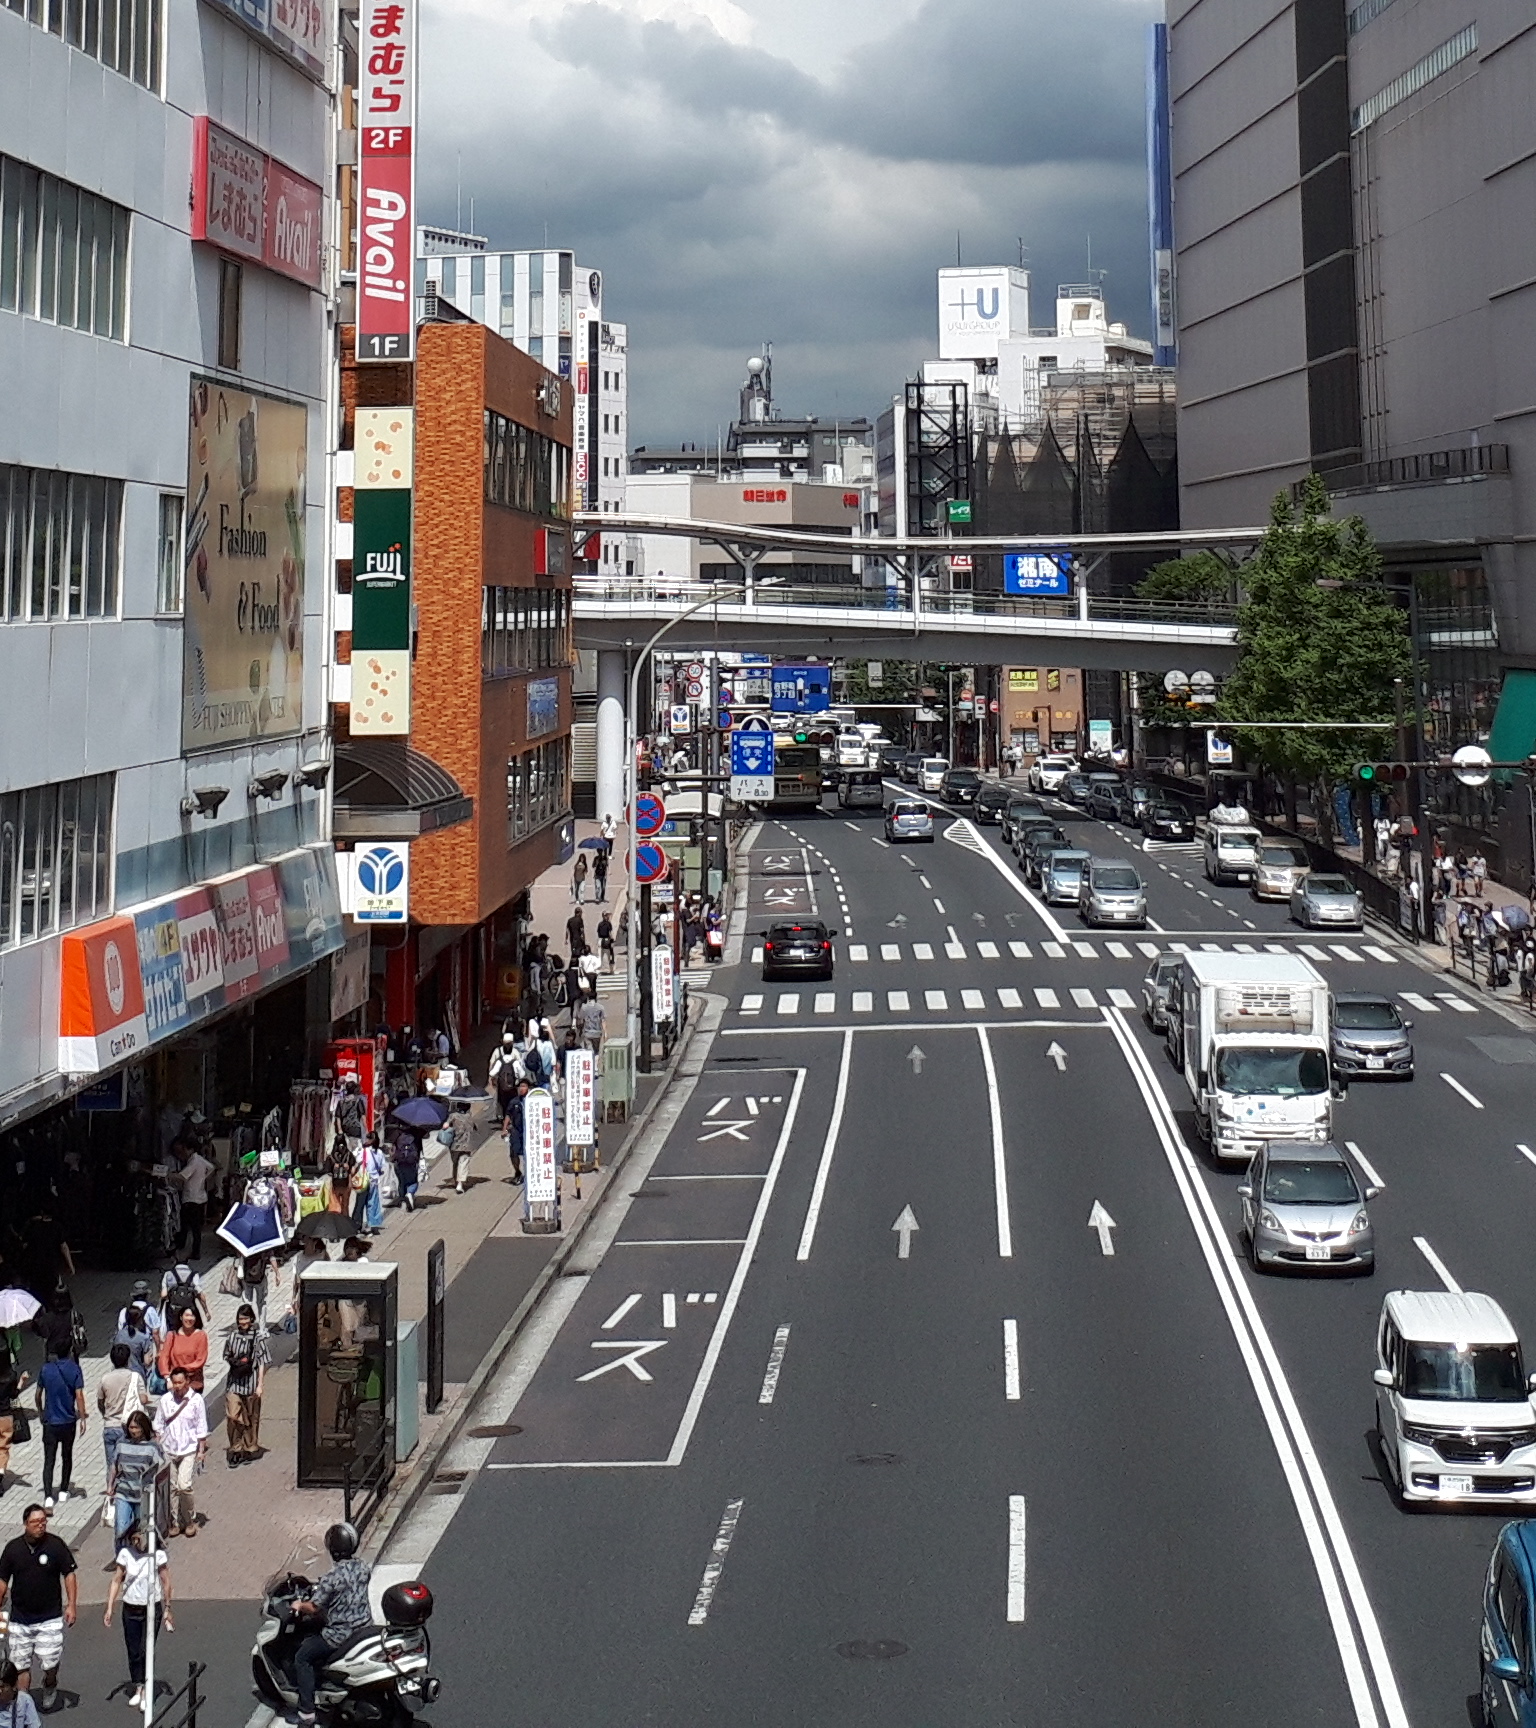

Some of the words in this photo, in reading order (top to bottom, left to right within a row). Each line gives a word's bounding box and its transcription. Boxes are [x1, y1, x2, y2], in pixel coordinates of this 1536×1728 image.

[370, 128, 403, 149] 2F
[209, 172, 258, 244] しまむら
[273, 195, 312, 271] Avail
[364, 187, 407, 303] Avail
[369, 336, 399, 356] 1F
[218, 498, 267, 559] Fashion
[366, 552, 401, 576] FUJI
[1017, 557, 1058, 578] 湘南
[1017, 578, 1059, 588] ゼミナール
[251, 574, 281, 636] Food
[739, 779, 765, 788] バス
[256, 897, 285, 953] Avail
[764, 888, 805, 906] バス
[582, 1059, 592, 1126] 駐停車禁止
[696, 1095, 783, 1143] バス
[541, 1106, 553, 1180] 駐停車禁止
[575, 1292, 718, 1382] バス
